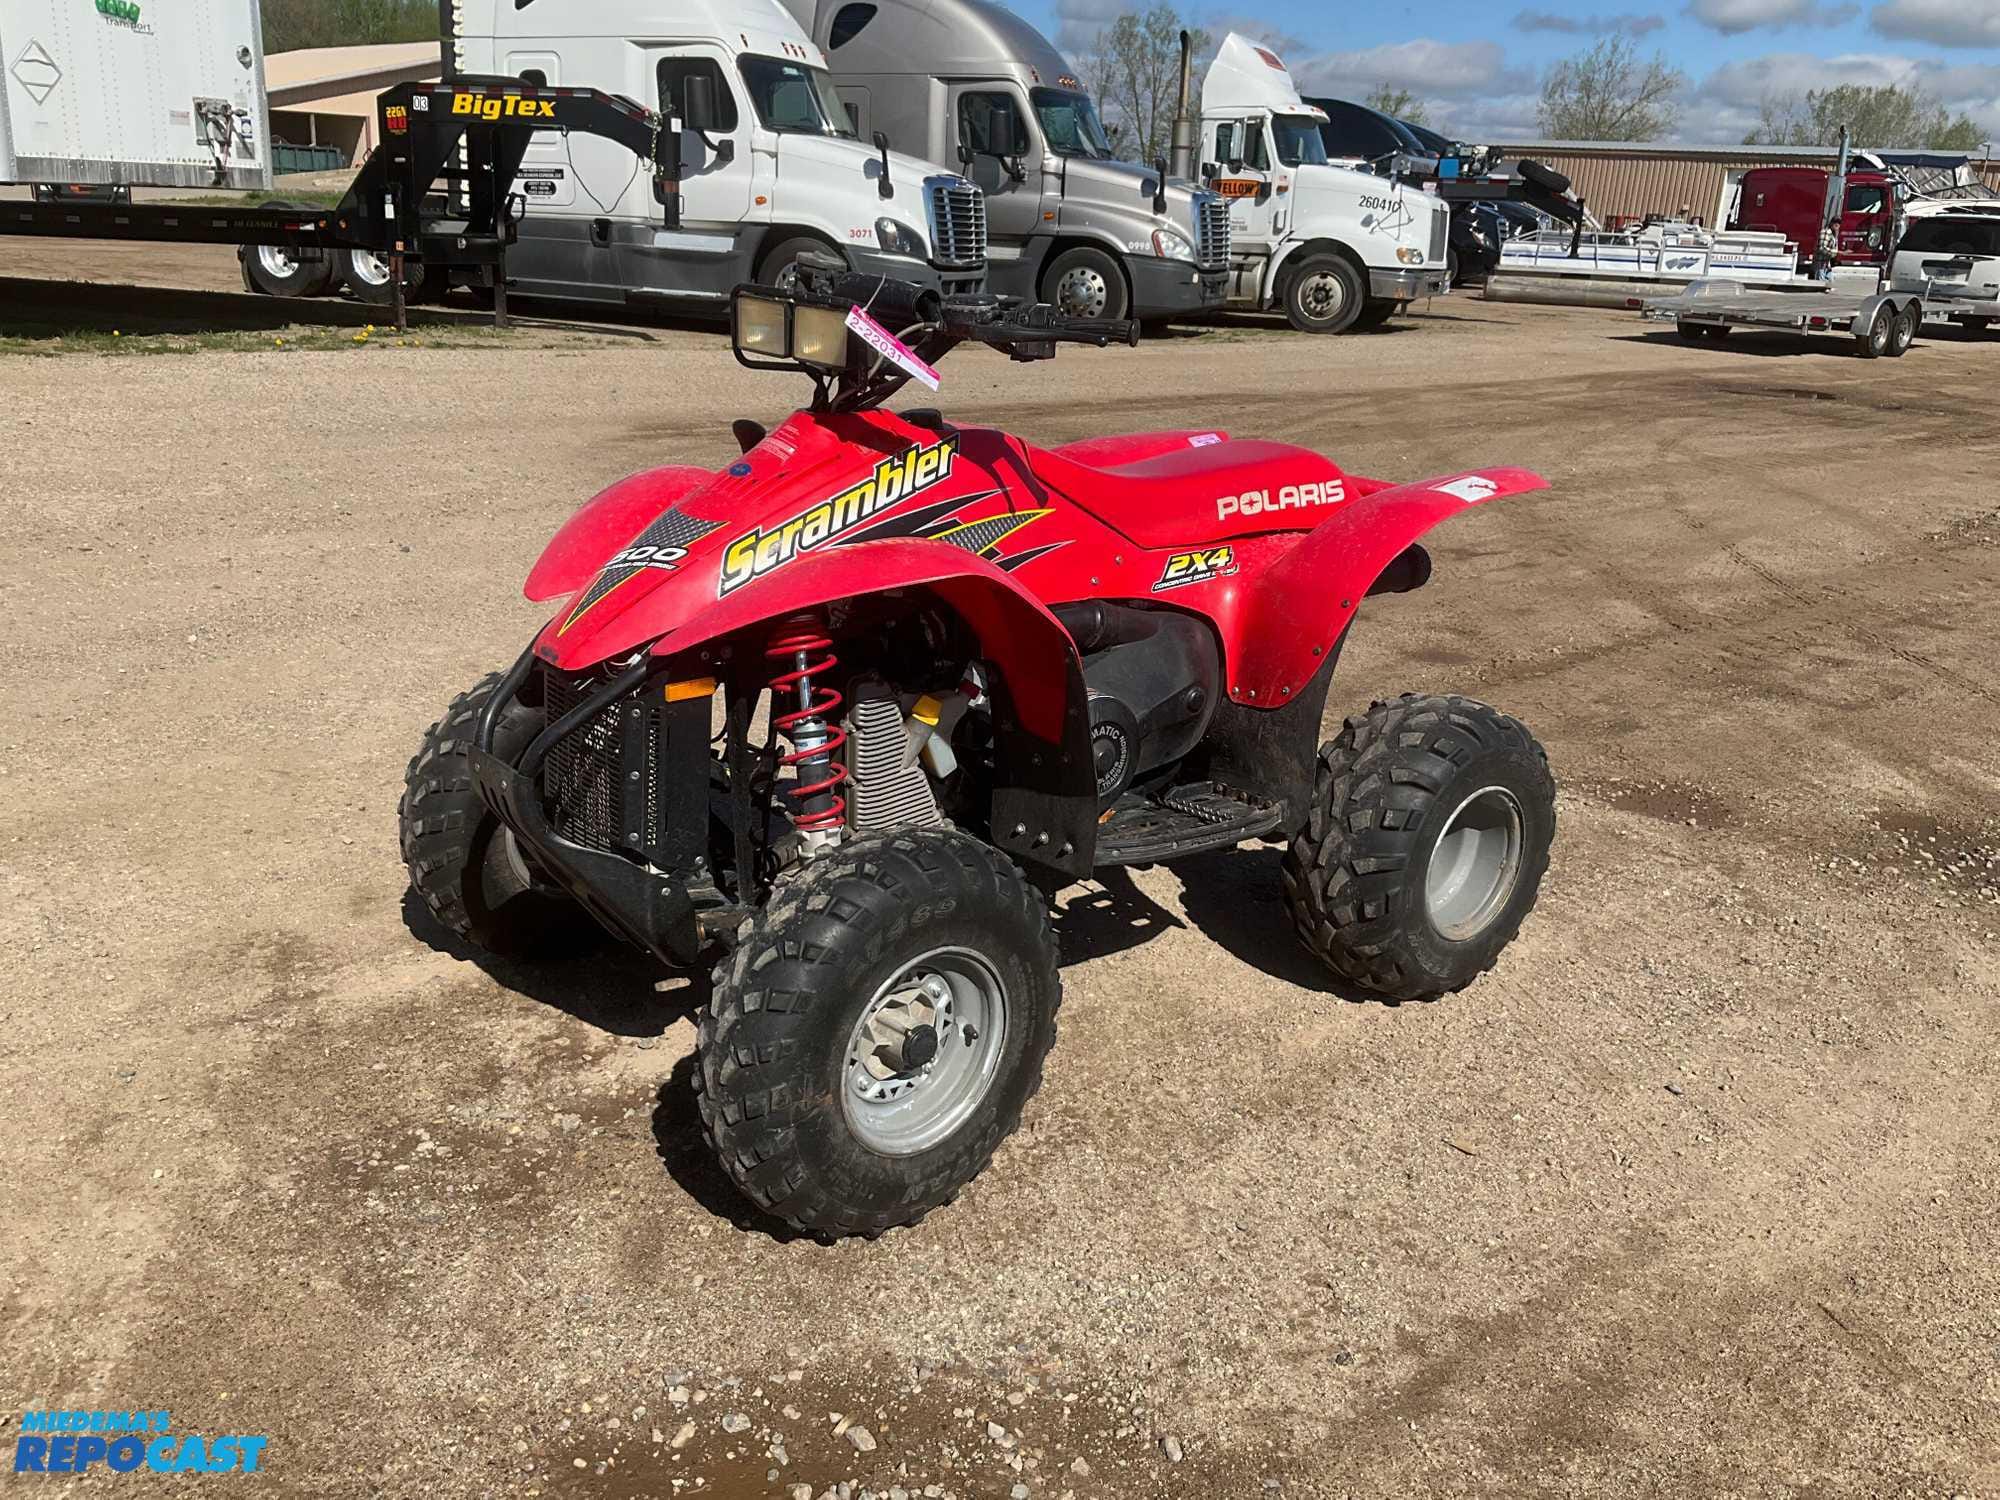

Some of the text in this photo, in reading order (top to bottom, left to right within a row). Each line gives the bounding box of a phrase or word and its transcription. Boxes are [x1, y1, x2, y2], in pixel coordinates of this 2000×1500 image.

[452, 93, 556, 120] BigTex
[1211, 181, 1257, 195] YELLOW
[849, 229, 872, 238] 3071
[849, 316, 902, 362] 2-22031
[719, 435, 958, 597] Scrambler
[1216, 478, 1345, 521] POLARIS
[1166, 547, 1231, 580] 2X4
